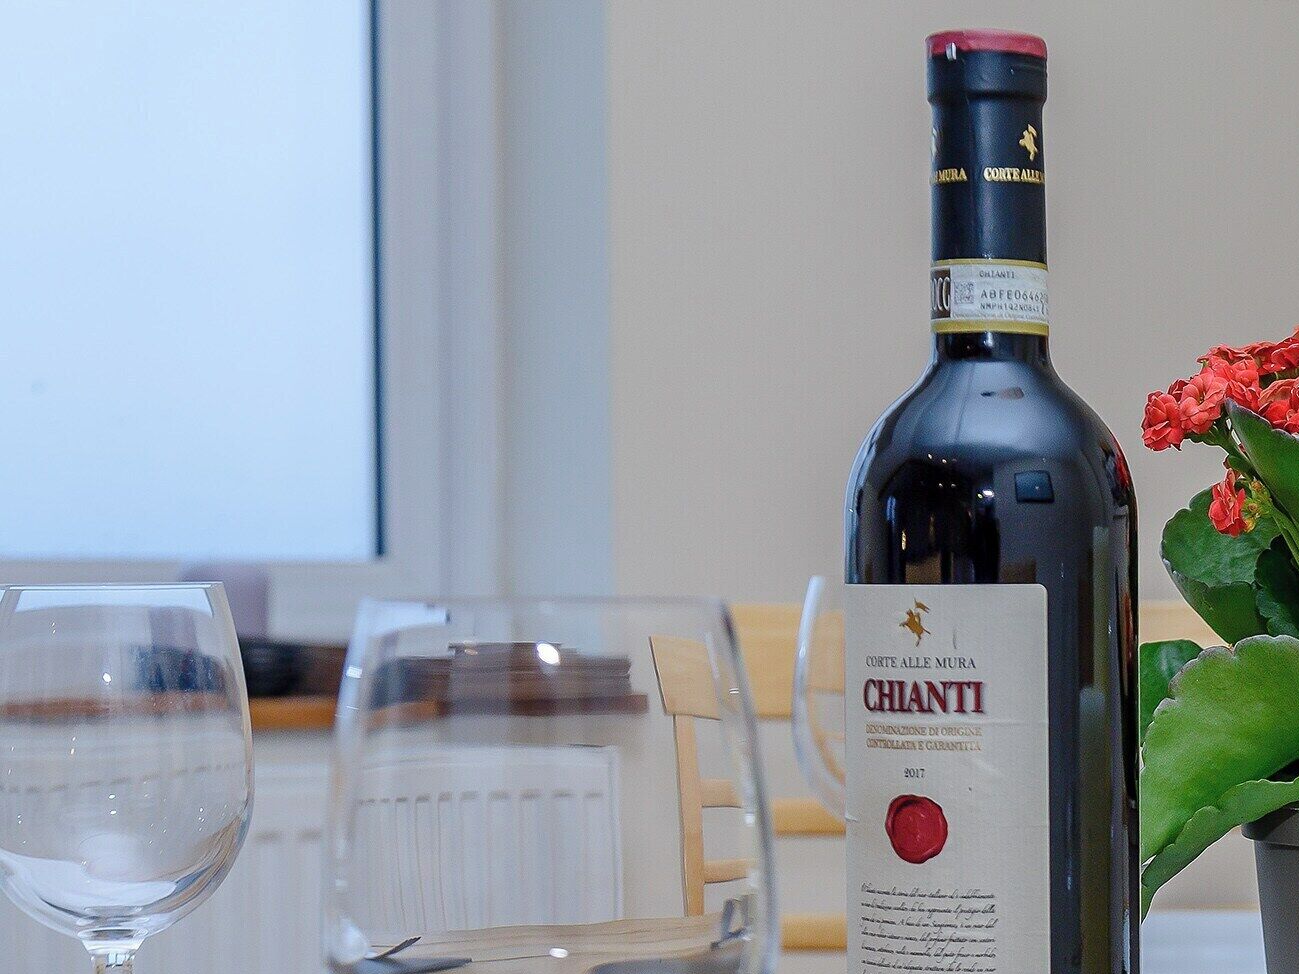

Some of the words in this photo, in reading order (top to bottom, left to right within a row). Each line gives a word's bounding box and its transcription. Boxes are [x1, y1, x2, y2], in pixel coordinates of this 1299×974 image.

[938, 167, 968, 183] MURA
[983, 167, 1020, 183] CORTE
[979, 269, 1015, 279] CHIANTI
[865, 655, 898, 668] CORTE
[900, 656, 931, 669] ALLE
[935, 657, 976, 669] MURA
[863, 678, 984, 713] CHIANTI
[928, 727, 939, 736] DI
[940, 727, 982, 737] ORIGINE
[918, 740, 926, 750] E
[925, 740, 981, 751] GARANTITA
[904, 767, 925, 778] 2017
